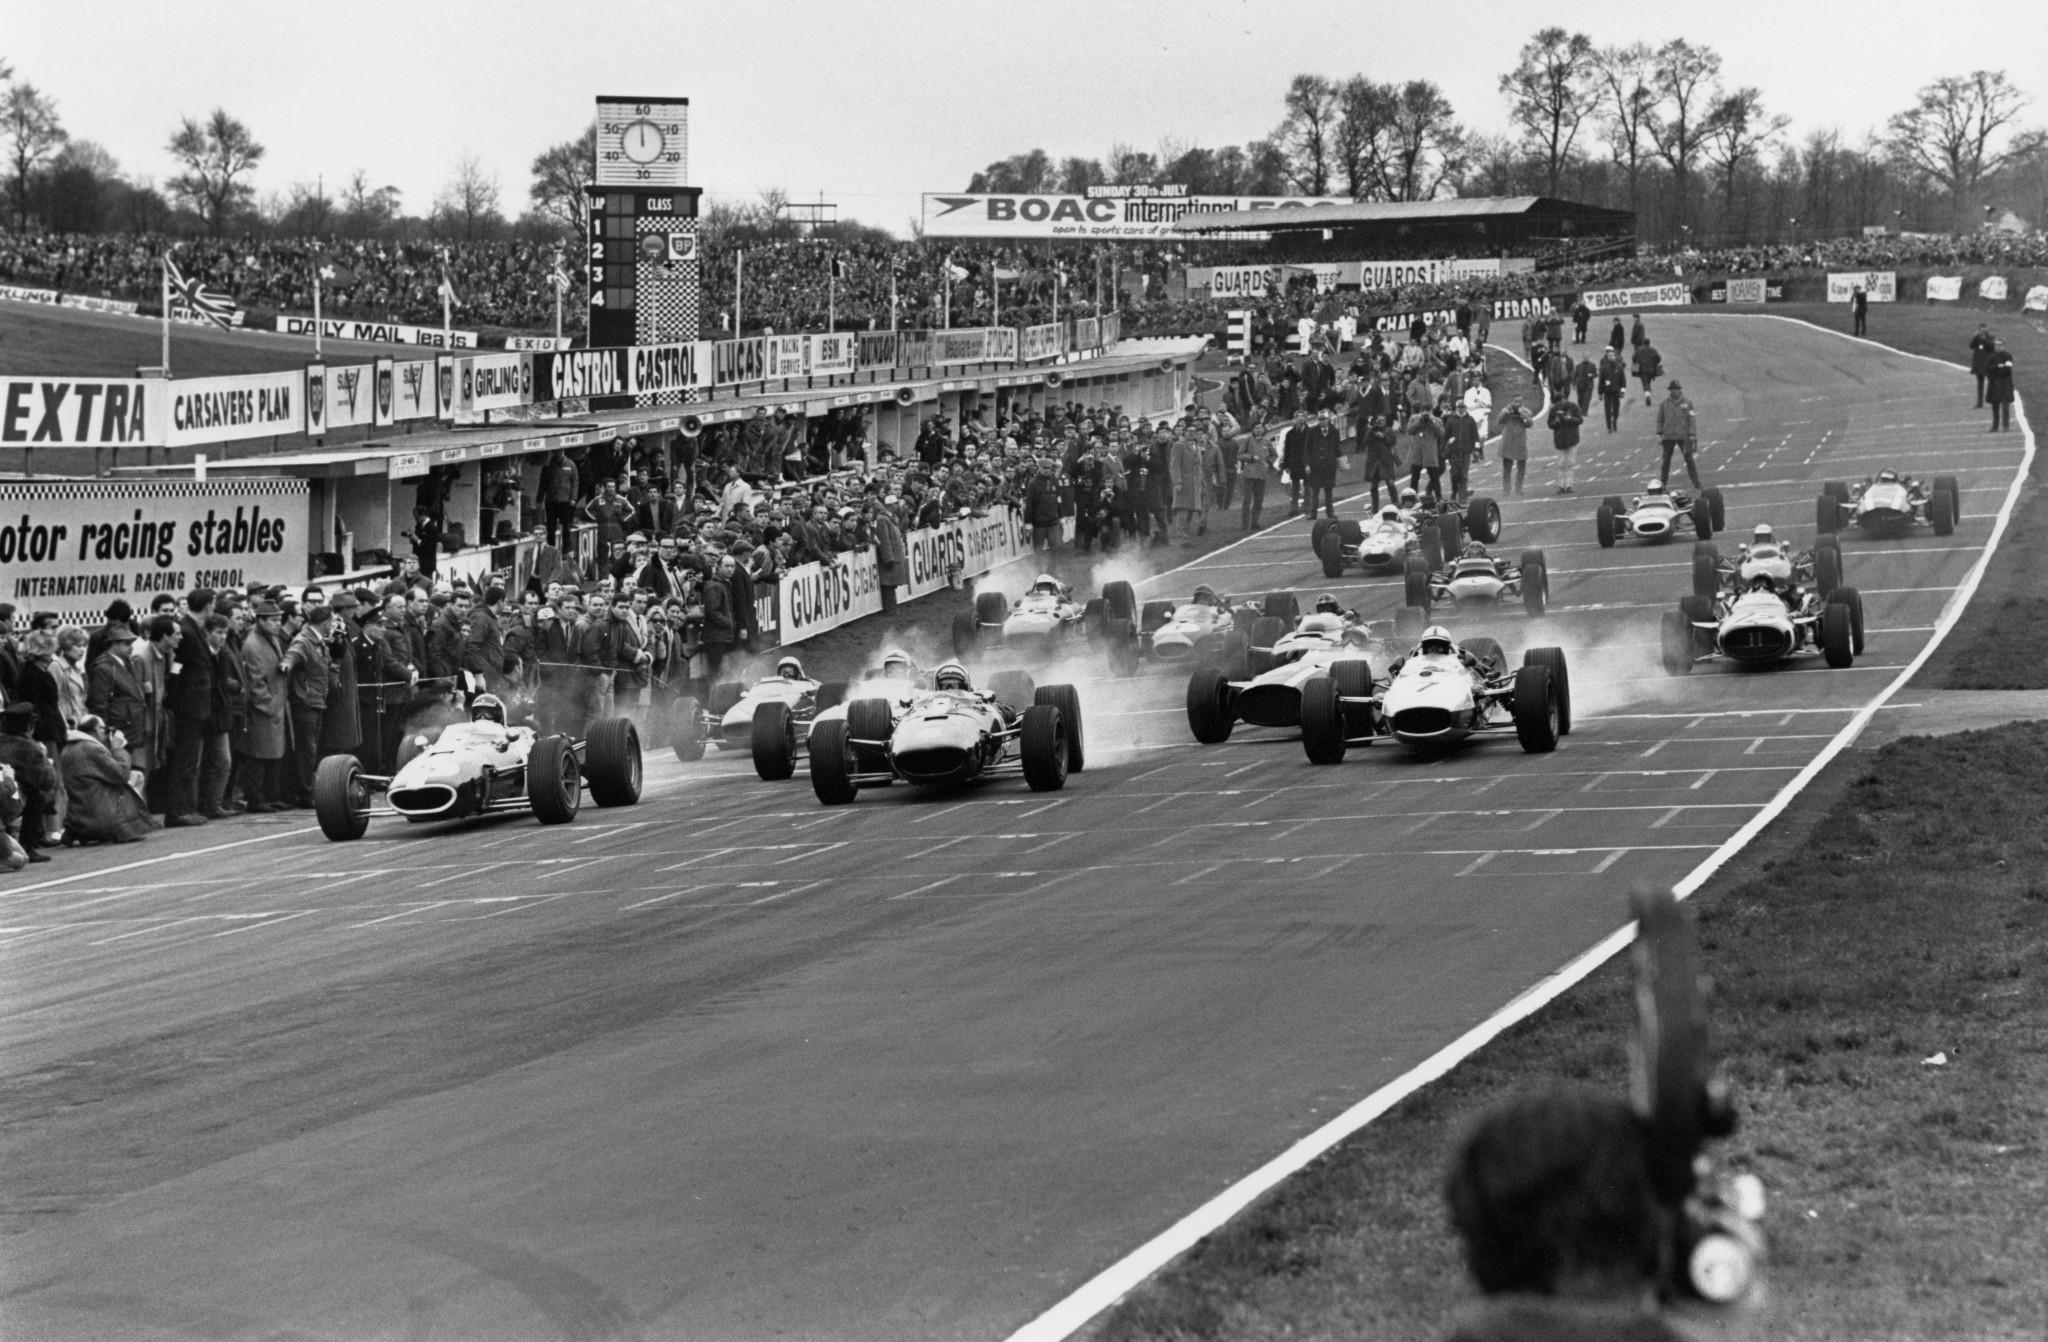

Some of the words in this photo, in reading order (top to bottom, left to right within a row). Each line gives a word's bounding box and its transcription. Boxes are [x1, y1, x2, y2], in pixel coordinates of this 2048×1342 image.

[636, 104, 650, 115] 60
[605, 123, 619, 134] 50
[666, 124, 679, 135] 10
[605, 151, 619, 161] 40
[666, 152, 680, 162] 20
[636, 170, 650, 179] 30
[1087, 186, 1131, 198] SUNDAY
[1133, 185, 1158, 197] 30th
[1160, 184, 1187, 197] JULY
[590, 197, 605, 210] LAP
[647, 198, 672, 211] CLASS
[987, 198, 1116, 222] BOAC
[594, 219, 601, 235] 1
[1053, 225, 1075, 235] open
[1079, 225, 1087, 234] to
[1091, 225, 1121, 235] sports
[1124, 226, 1144, 235] cars
[592, 243, 604, 258] 2
[592, 266, 604, 282] 3
[1214, 269, 1270, 292] GUARDS
[1363, 265, 1427, 288] GUARDS
[591, 290, 605, 306] 4
[1596, 291, 1628, 307] BOAC
[1660, 286, 1681, 301] 500
[1495, 297, 1550, 319] FERODO
[287, 318, 346, 339] DAILY
[354, 324, 406, 344] MAIL
[416, 329, 467, 348] leads
[822, 338, 840, 361] BSM
[636, 345, 698, 392] CASTROL
[717, 340, 763, 384] LUCAS
[475, 364, 519, 398] GIRLING
[552, 350, 621, 399] CASTROL
[2, 382, 145, 442] EXTRA
[174, 390, 254, 431] CARSAVERS
[259, 386, 290, 423] PLAN
[79, 508, 176, 568] racing
[188, 505, 285, 557] stables
[914, 527, 965, 585] GUARDS
[968, 521, 1007, 558] CIGARETTES
[14, 573, 126, 599] INTERNATIONAL
[134, 570, 185, 593] RACING
[195, 568, 245, 590] SCHOOL
[791, 563, 850, 629] GUARDS
[854, 563, 880, 597] CIGAR
